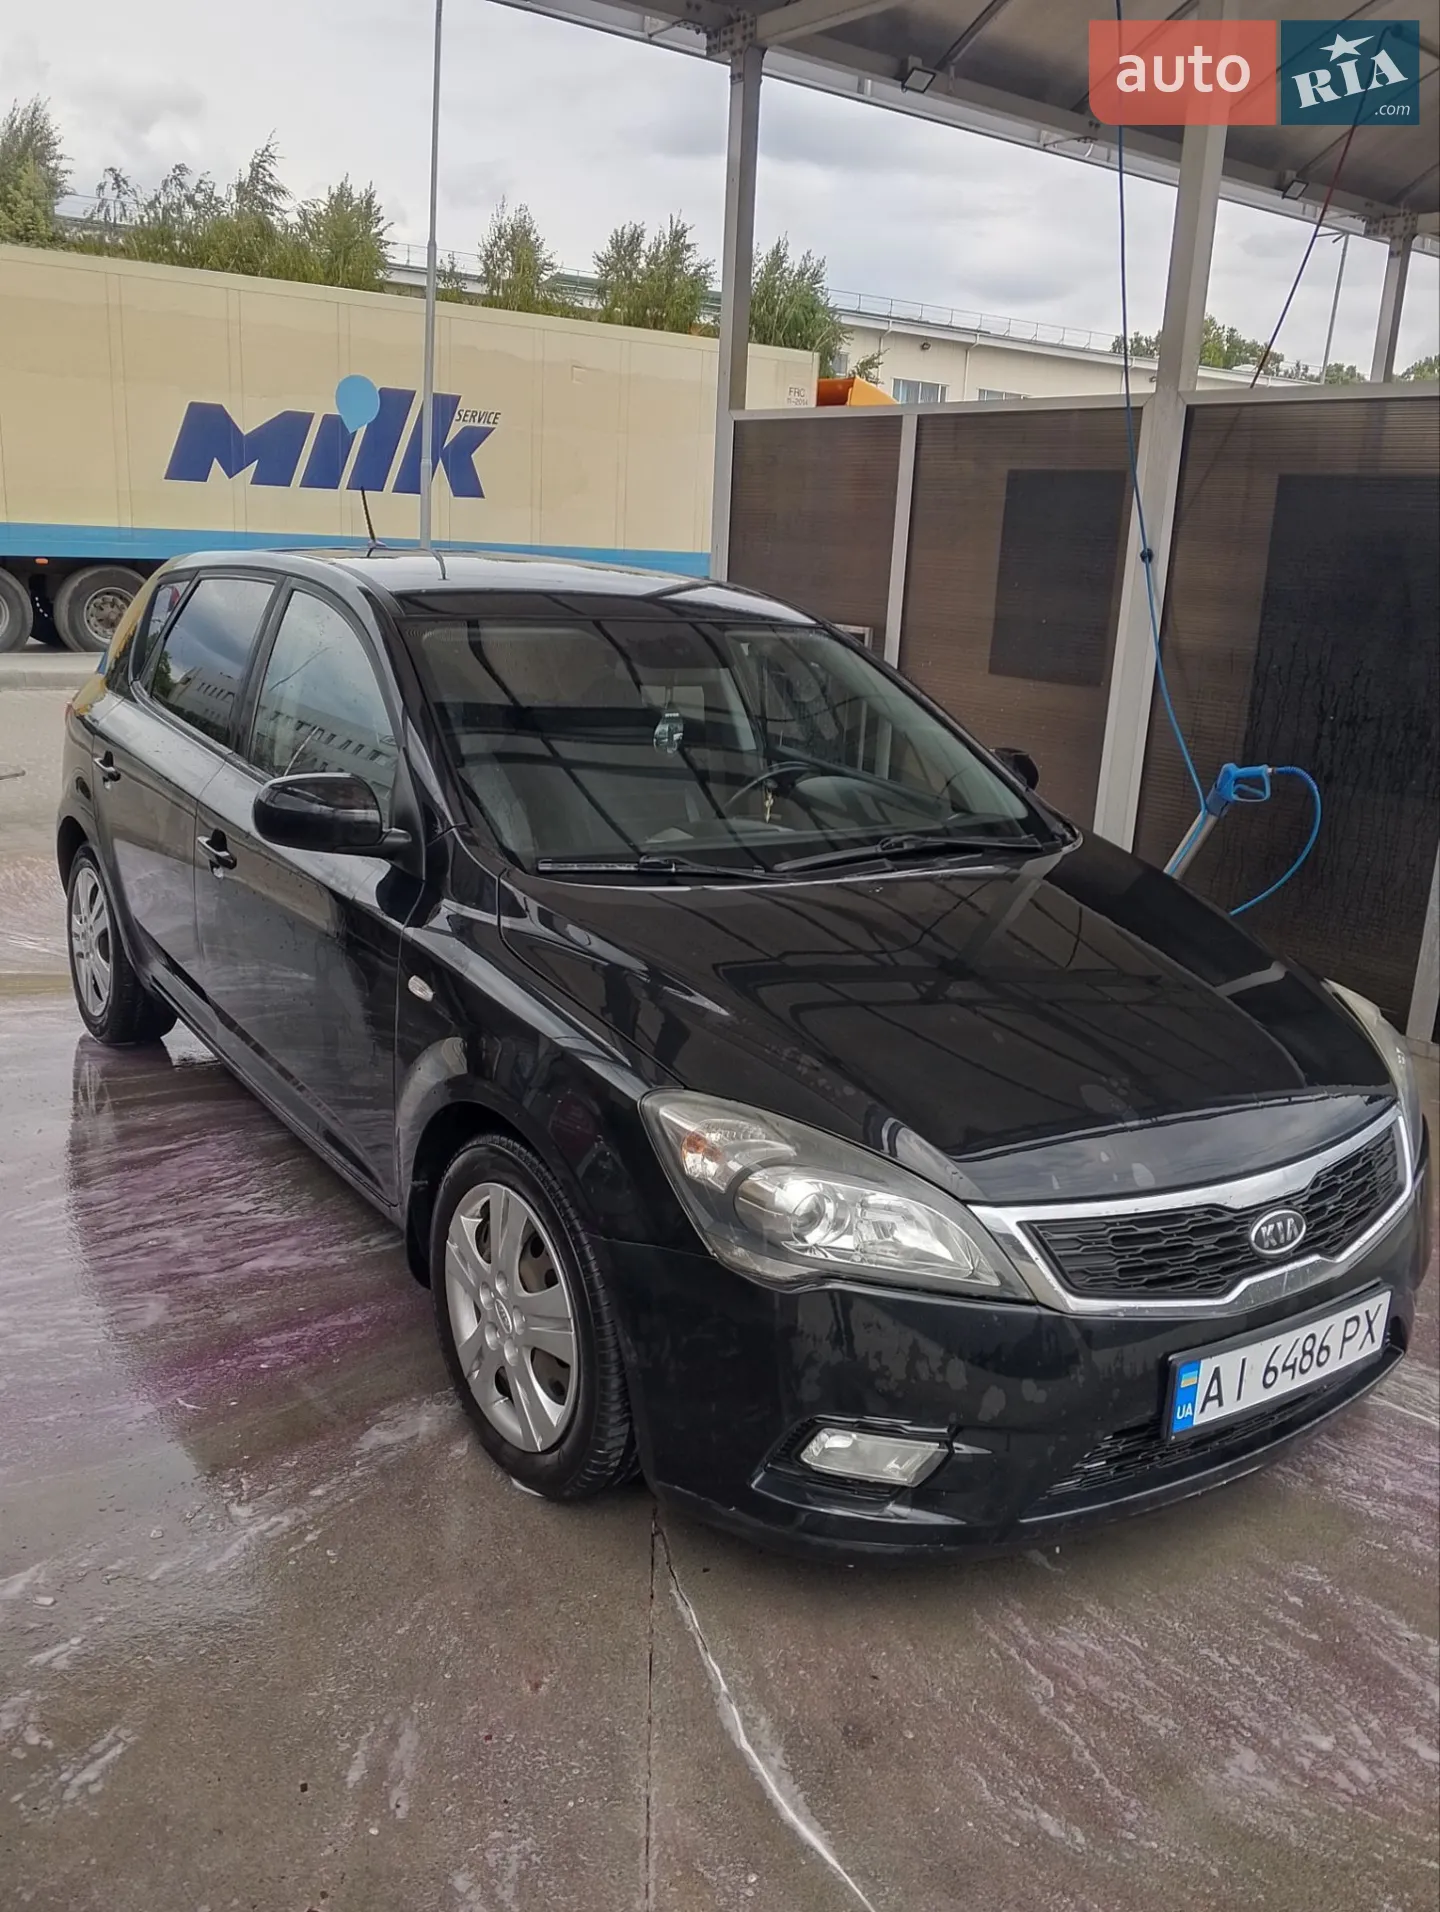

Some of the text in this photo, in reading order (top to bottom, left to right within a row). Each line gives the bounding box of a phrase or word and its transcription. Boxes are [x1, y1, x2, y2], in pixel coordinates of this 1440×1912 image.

[788, 387, 805, 397] FRC
[455, 409, 501, 425] SERVICE
[1260, 1217, 1300, 1248] KIA
[1198, 1303, 1383, 1415] AI 6486 PX
[1176, 1404, 1194, 1420] UA
